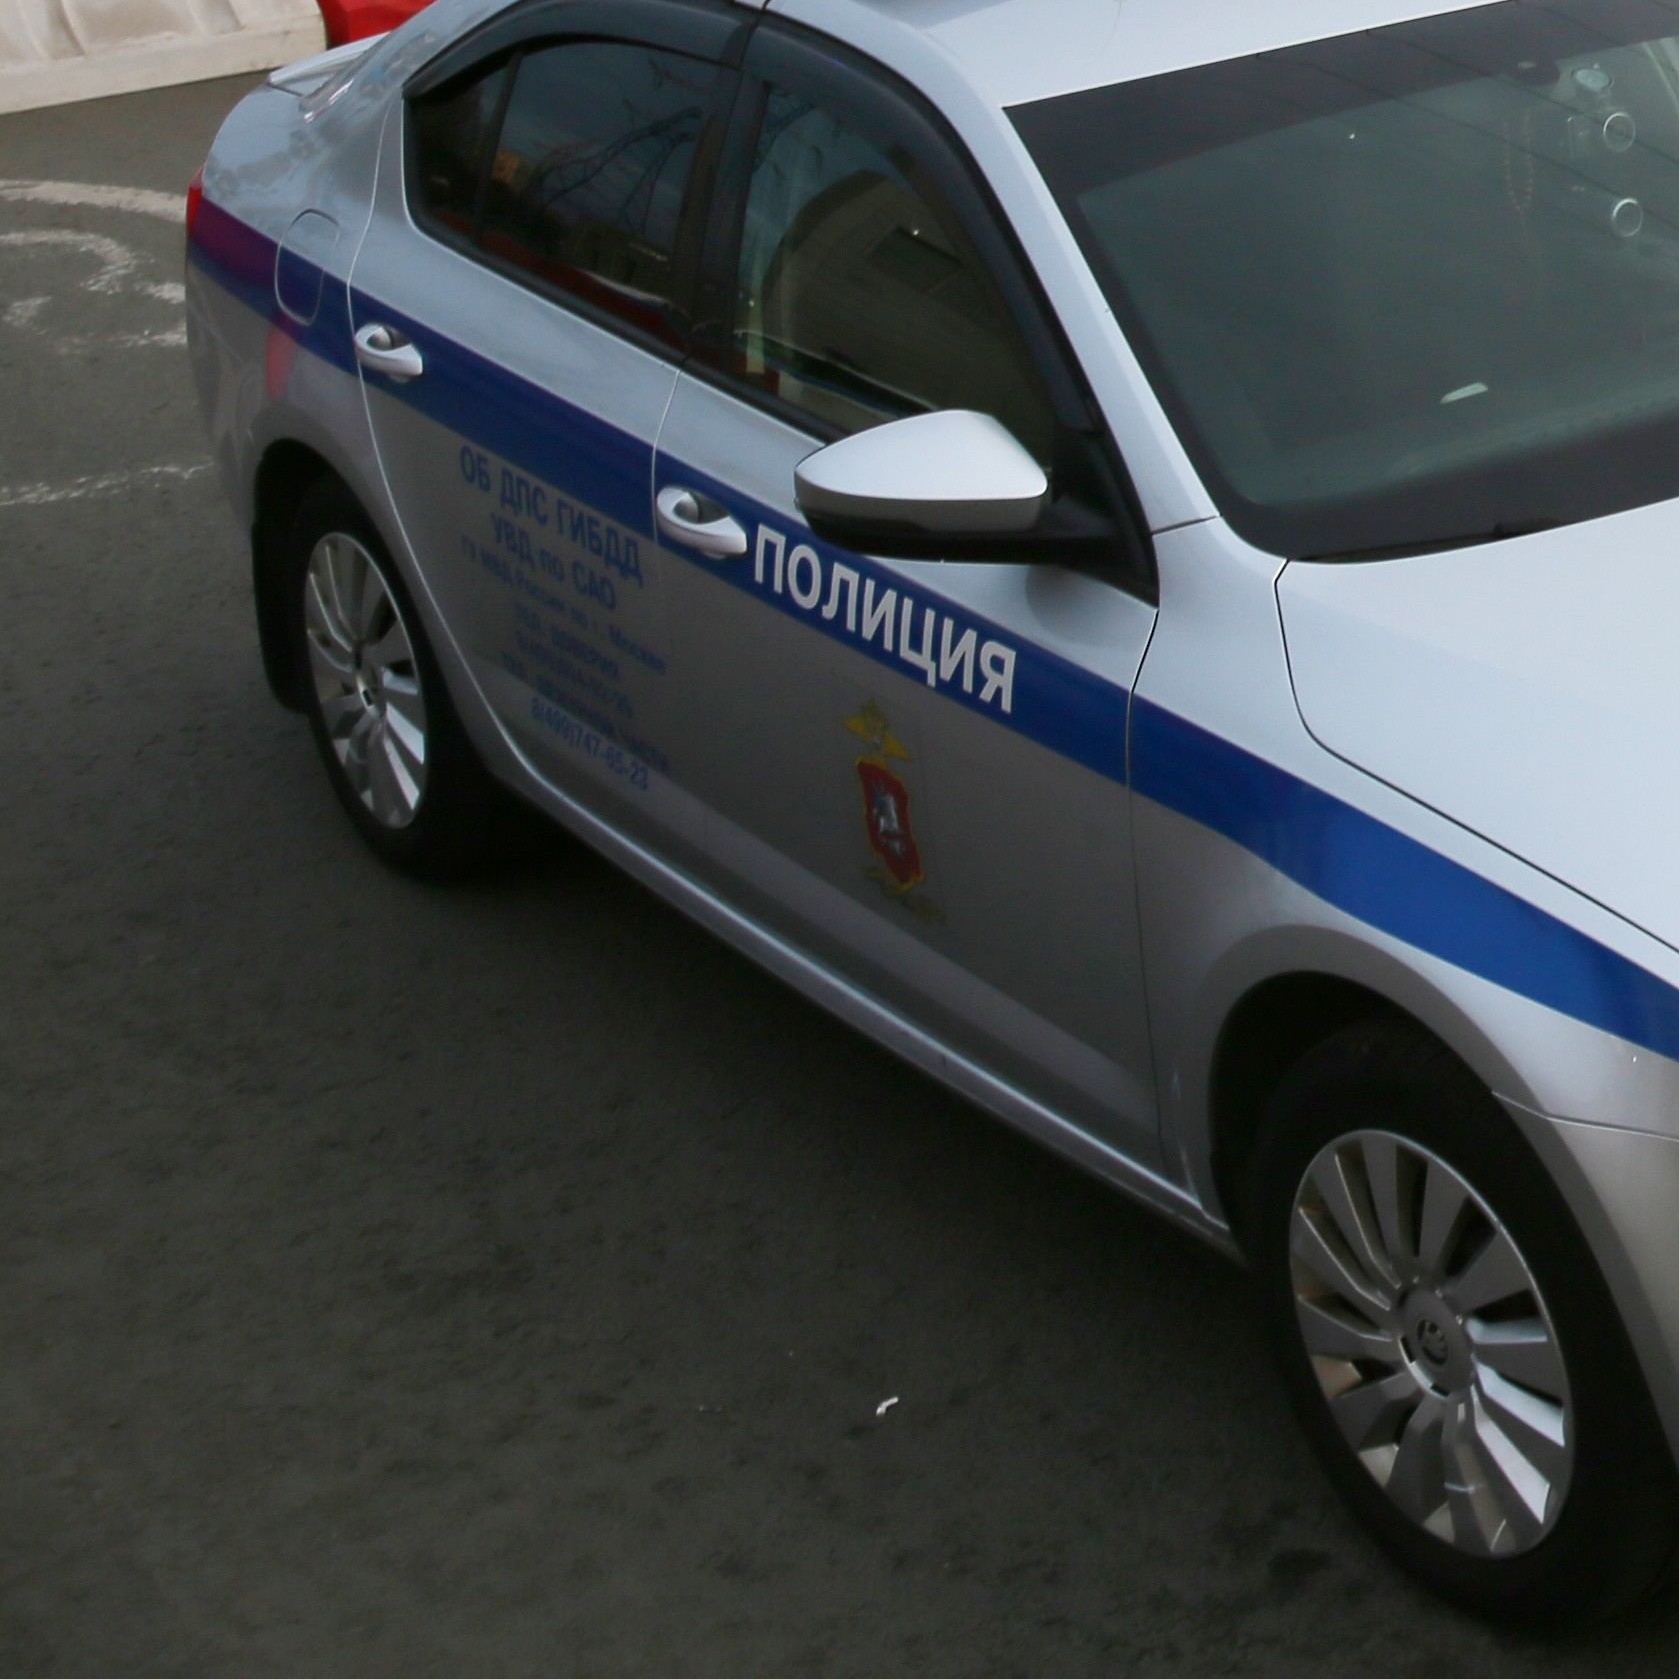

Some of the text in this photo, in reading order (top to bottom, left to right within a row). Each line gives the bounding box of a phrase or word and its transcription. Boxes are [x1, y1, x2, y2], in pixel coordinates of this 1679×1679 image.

[459, 445, 644, 588] ОБ ДПС ГИБДД
[490, 512, 534, 570] УВД
[571, 560, 617, 612] САО
[754, 523, 1018, 714] ПОЛИЦИЯ
